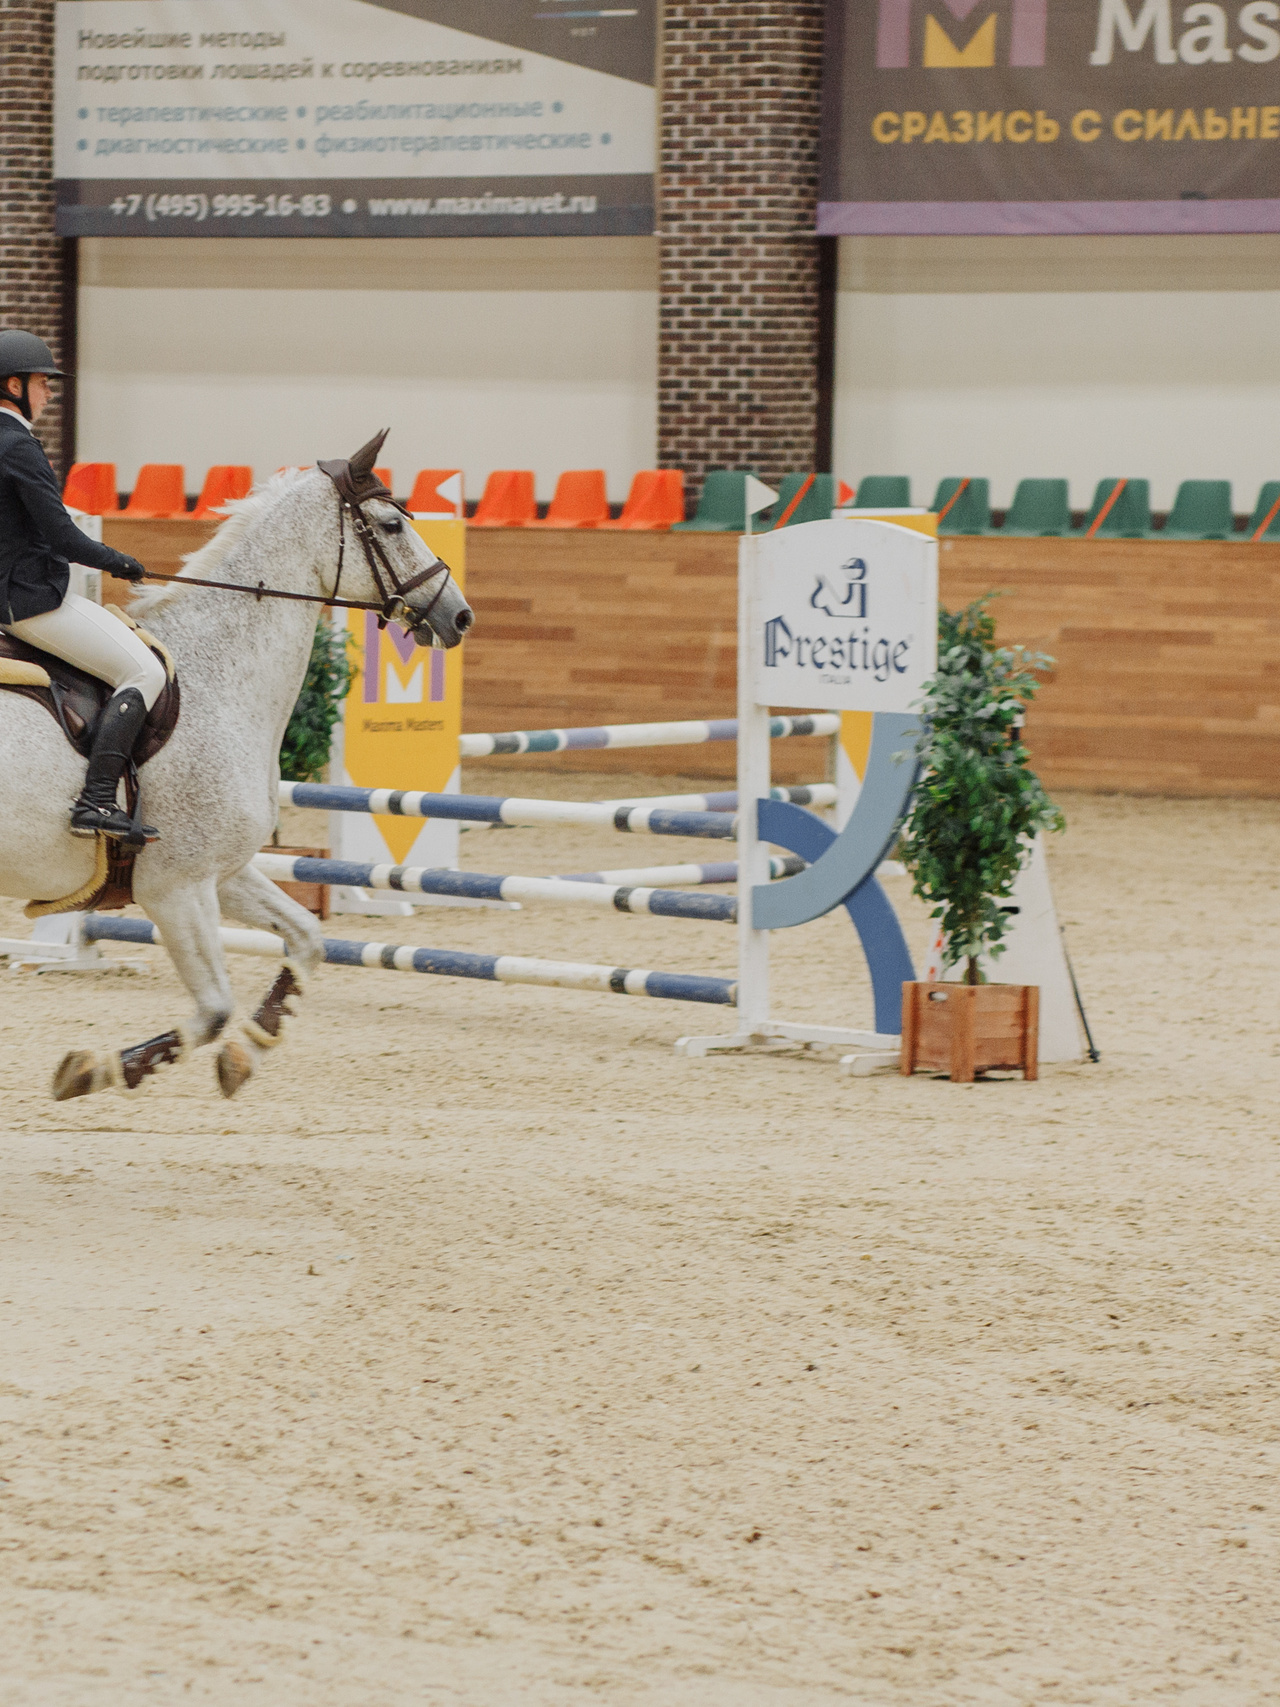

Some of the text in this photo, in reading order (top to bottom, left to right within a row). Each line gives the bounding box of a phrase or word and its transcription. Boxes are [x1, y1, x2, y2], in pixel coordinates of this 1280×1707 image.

[78, 27, 286, 50] Новейшие методы
[77, 56, 524, 83] подготовки лошадей к соревнованиям
[96, 99, 544, 126] терапевтические реабилитационные
[871, 106, 1280, 143] СРАЗИСЬ С СИЛЬНЕ
[93, 133, 592, 157] диагностические физиотерапевтические
[110, 194, 143, 216] +7
[145, 193, 209, 221] (495)
[370, 191, 597, 216] www.maximavet.ru
[764, 615, 910, 682] Prestige
